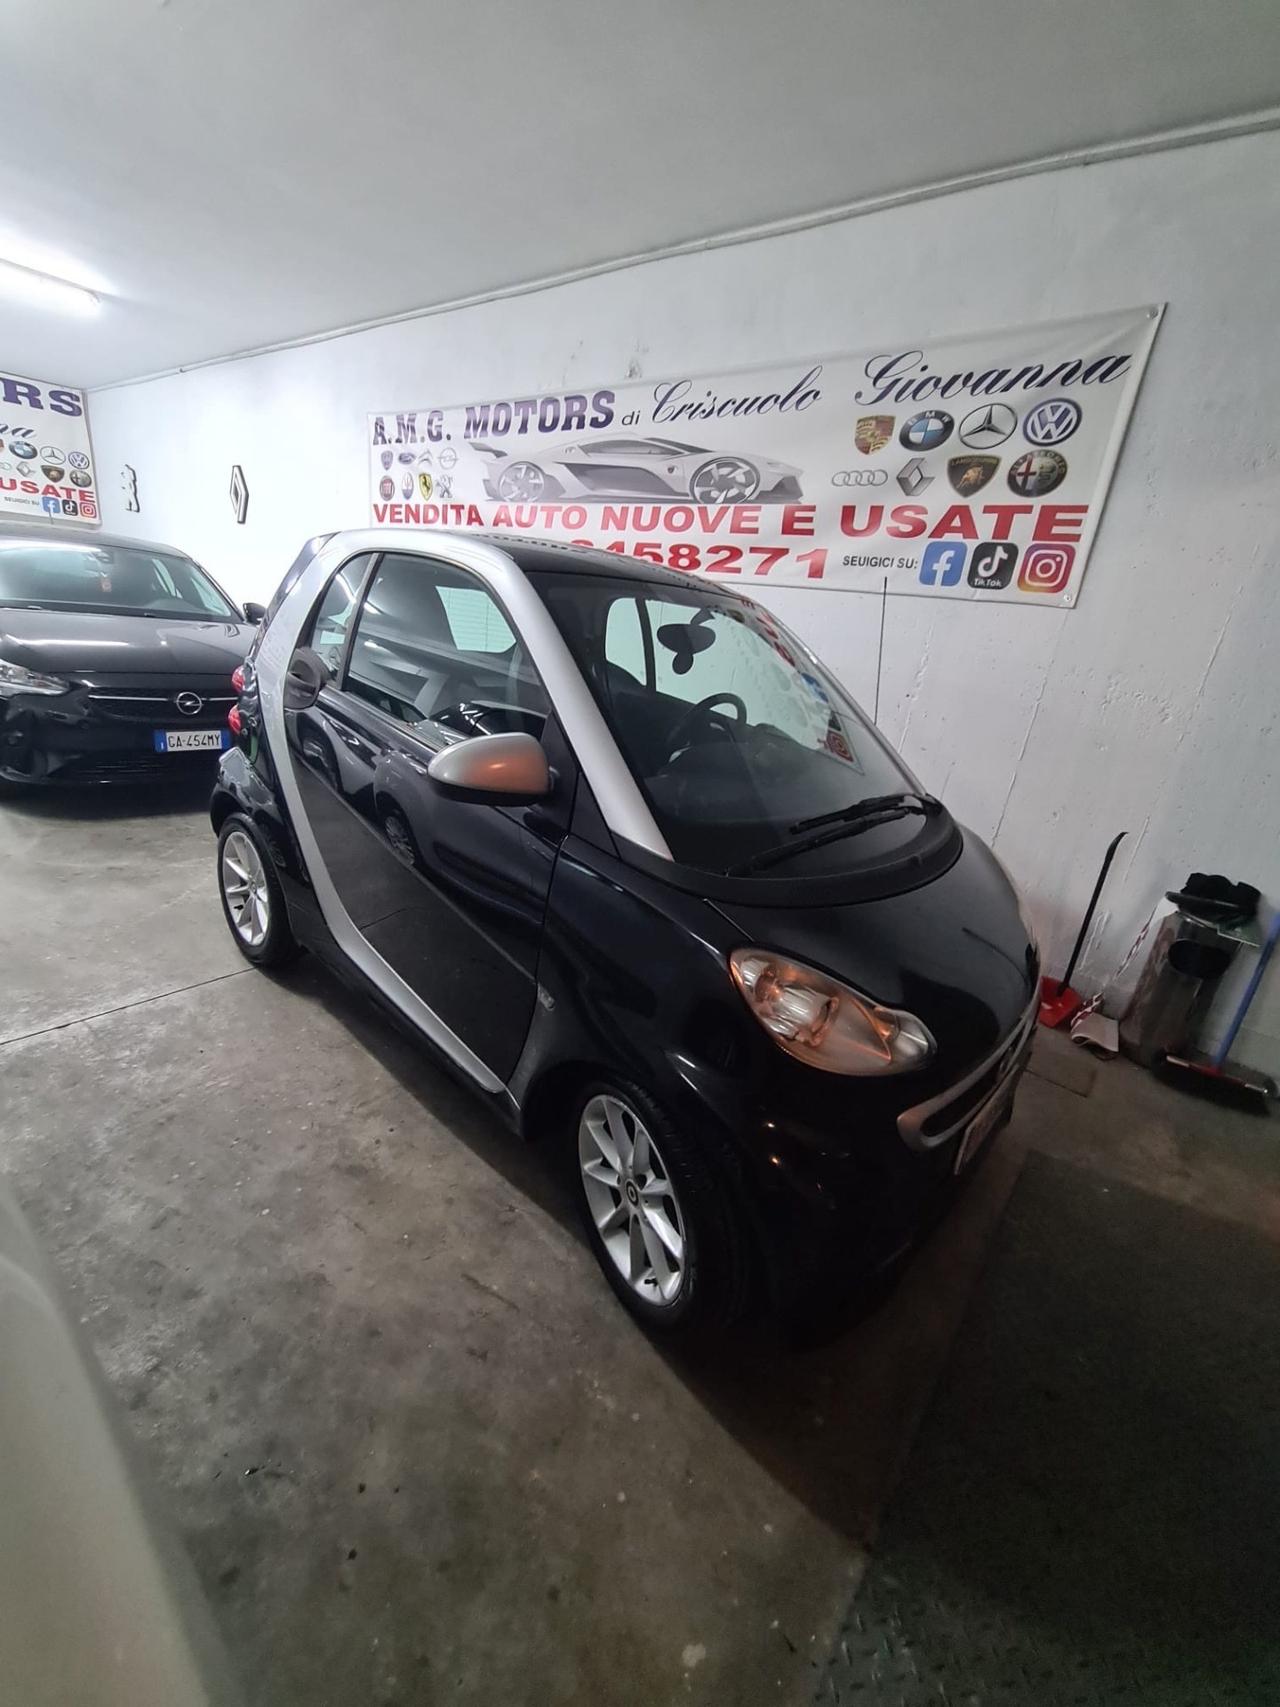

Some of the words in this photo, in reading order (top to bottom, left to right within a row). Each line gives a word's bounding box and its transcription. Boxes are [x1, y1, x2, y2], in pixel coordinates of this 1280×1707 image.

[373, 410, 452, 445] A.M.G.
[463, 389, 616, 440] MOTORS
[621, 409, 641, 426] di
[652, 365, 823, 424] Criscuolo
[854, 350, 1134, 406] Giovanna
[372, 503, 484, 527] VENDITA
[492, 504, 588, 530] AUTO
[599, 504, 763, 535] NUOVE
[781, 504, 816, 536] E
[839, 504, 1090, 543] USATE
[842, 555, 894, 569] SEUIGICI
[896, 556, 919, 570] SU:
